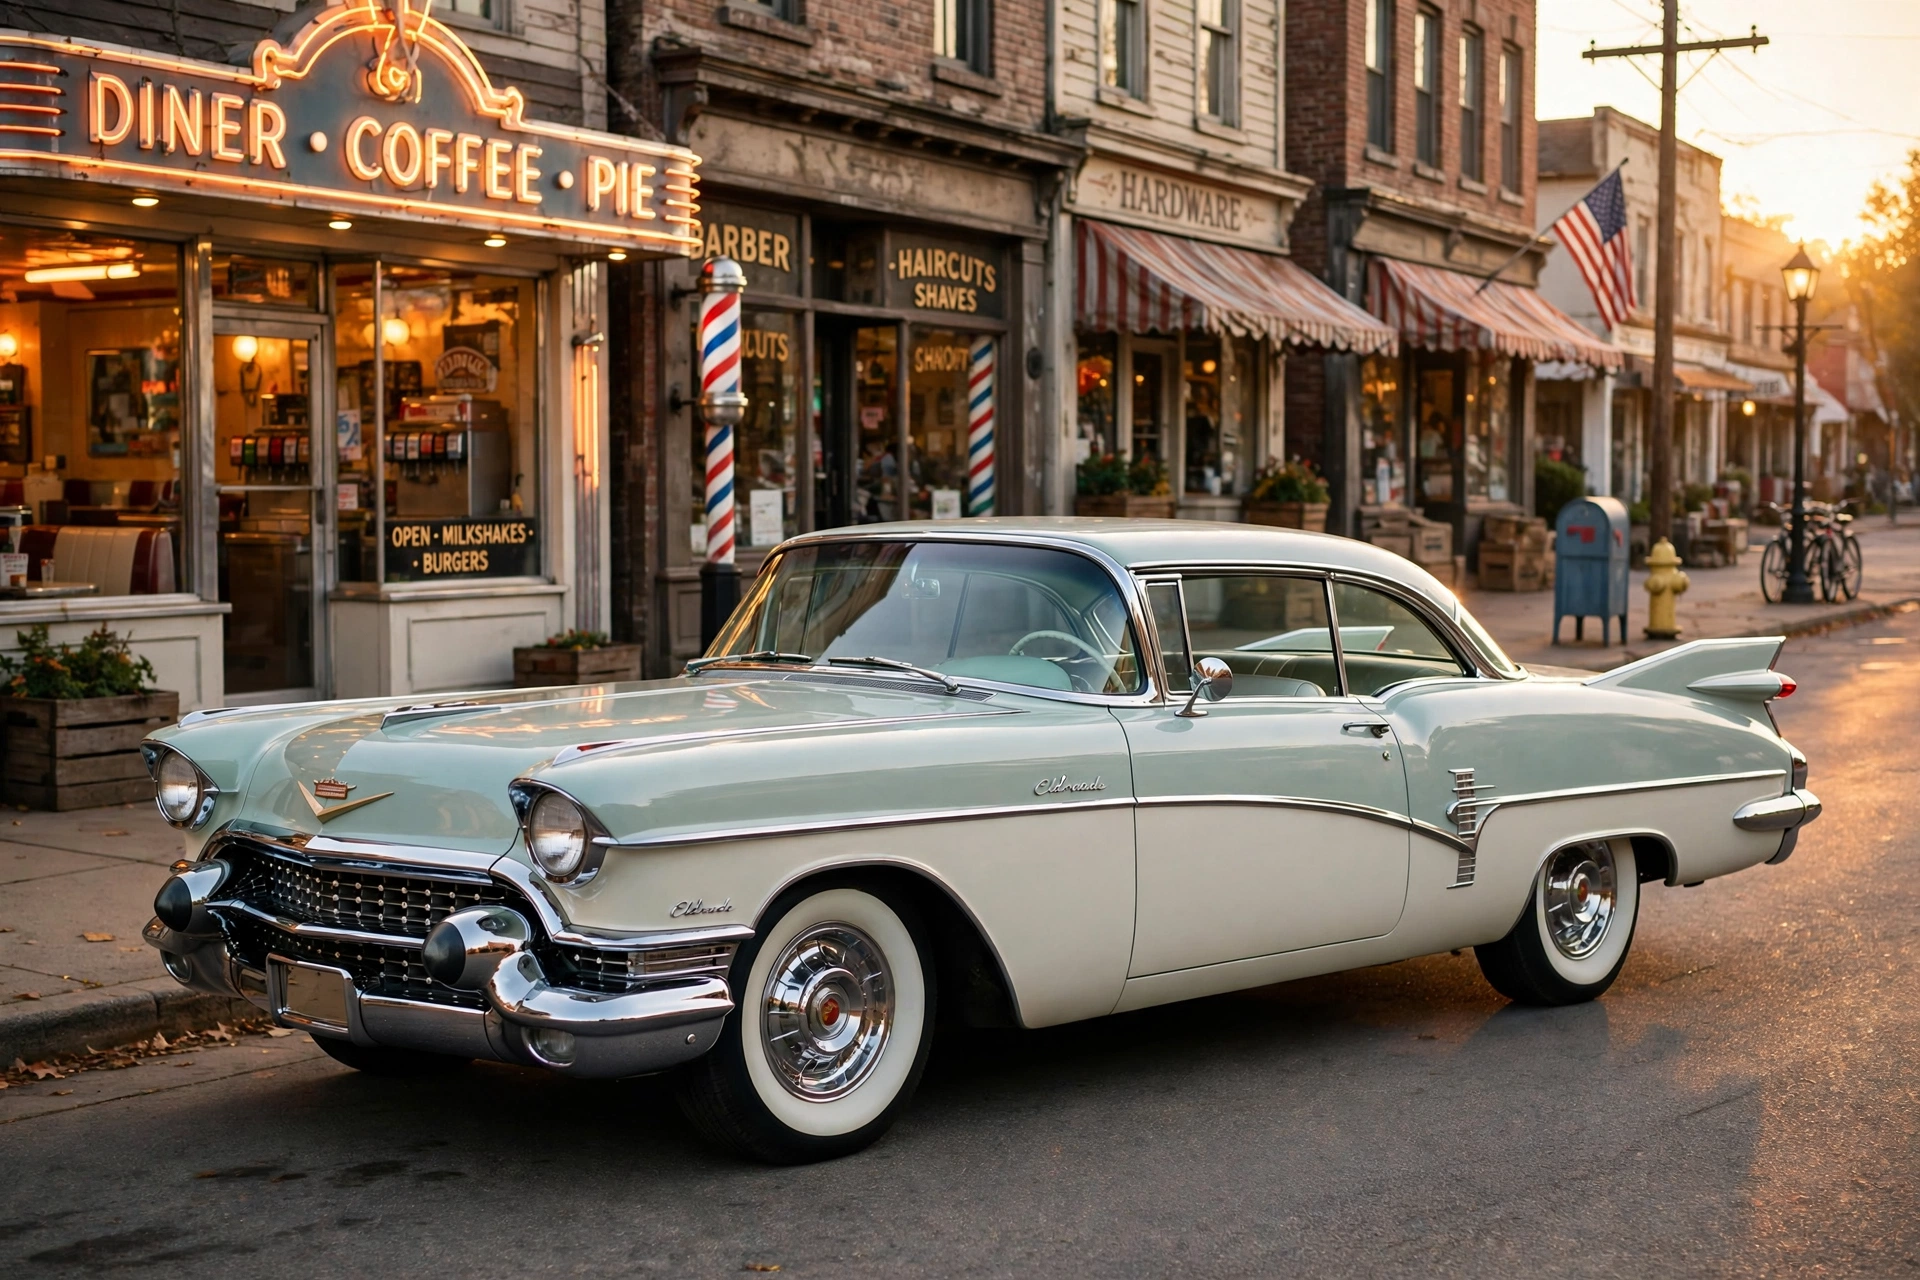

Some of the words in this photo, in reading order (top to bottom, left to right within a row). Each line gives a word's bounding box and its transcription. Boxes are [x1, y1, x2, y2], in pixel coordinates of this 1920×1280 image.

[90, 71, 287, 169] DINER
[345, 115, 543, 204] COFFEE
[587, 155, 657, 220] PIE
[1120, 170, 1242, 232] HARDWARE
[898, 248, 996, 293] HAIRCUTS
[914, 282, 978, 313] SHAVES
[392, 526, 431, 547] OPEN
[442, 523, 526, 545] MILKSHAKES
[423, 550, 488, 574] BURGERS
